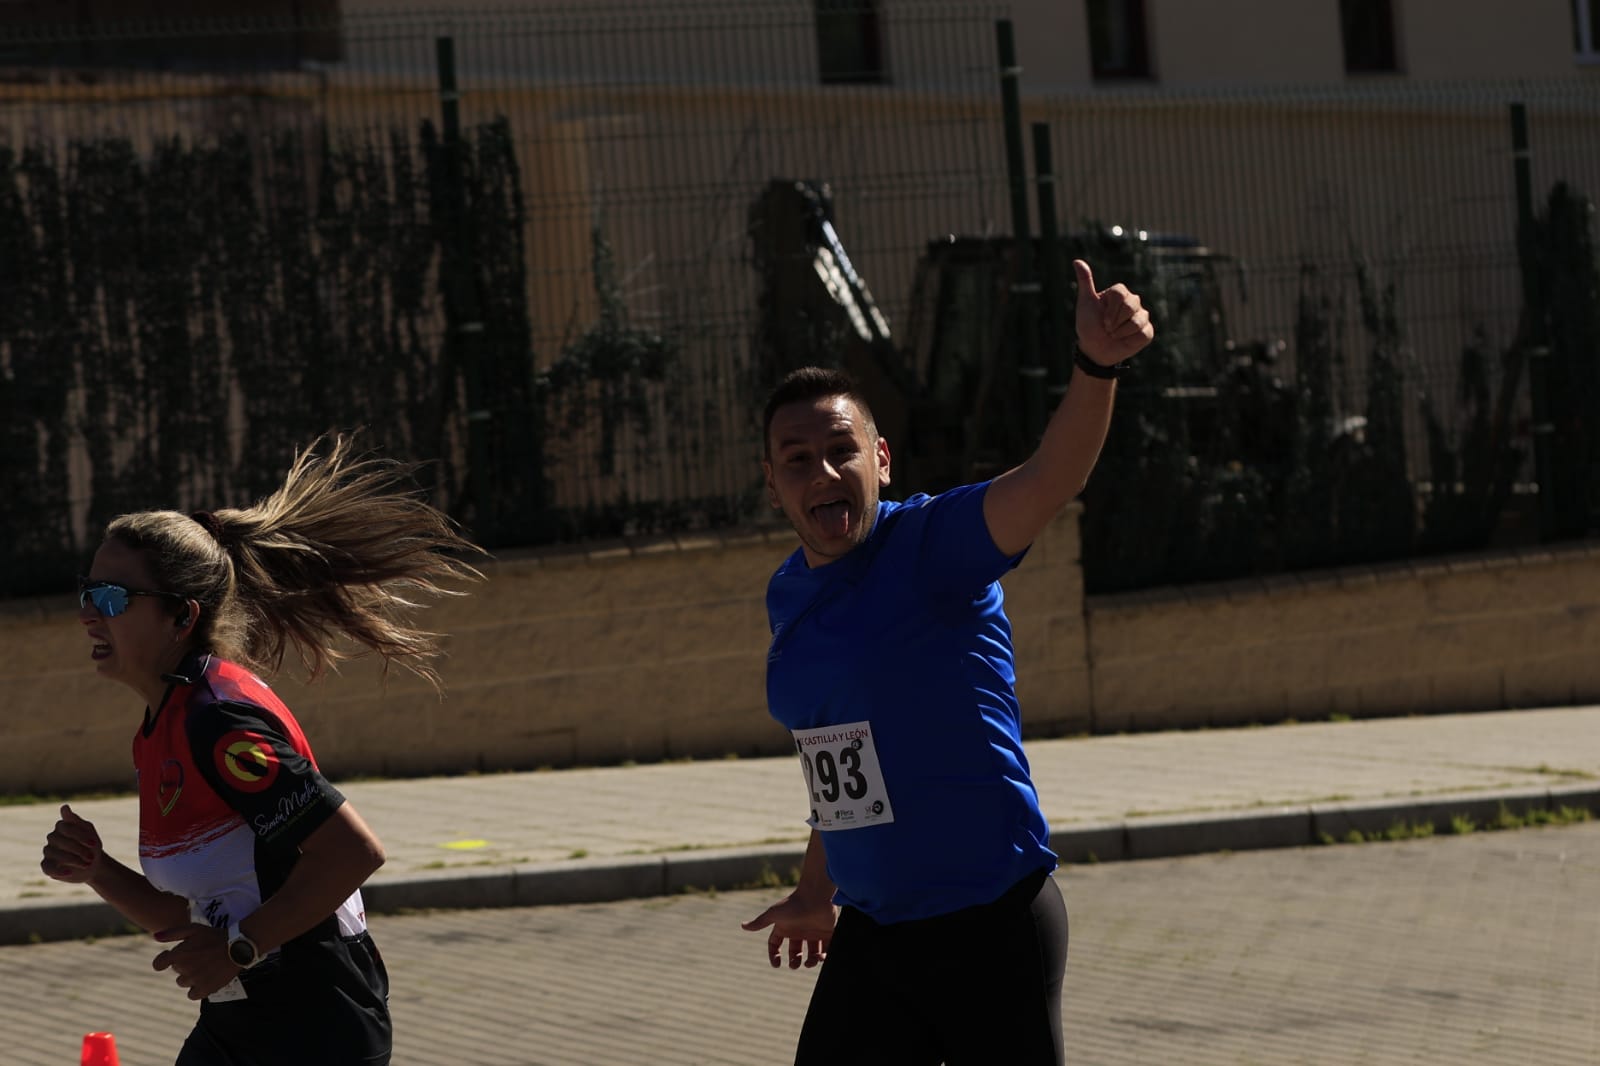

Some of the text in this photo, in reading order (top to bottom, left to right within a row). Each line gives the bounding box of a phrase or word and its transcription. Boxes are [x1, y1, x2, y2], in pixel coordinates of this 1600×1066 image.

[805, 734, 837, 746] CASTILLA
[838, 732, 844, 742] Y
[845, 728, 868, 741] LEÓN
[802, 747, 868, 803] 293
